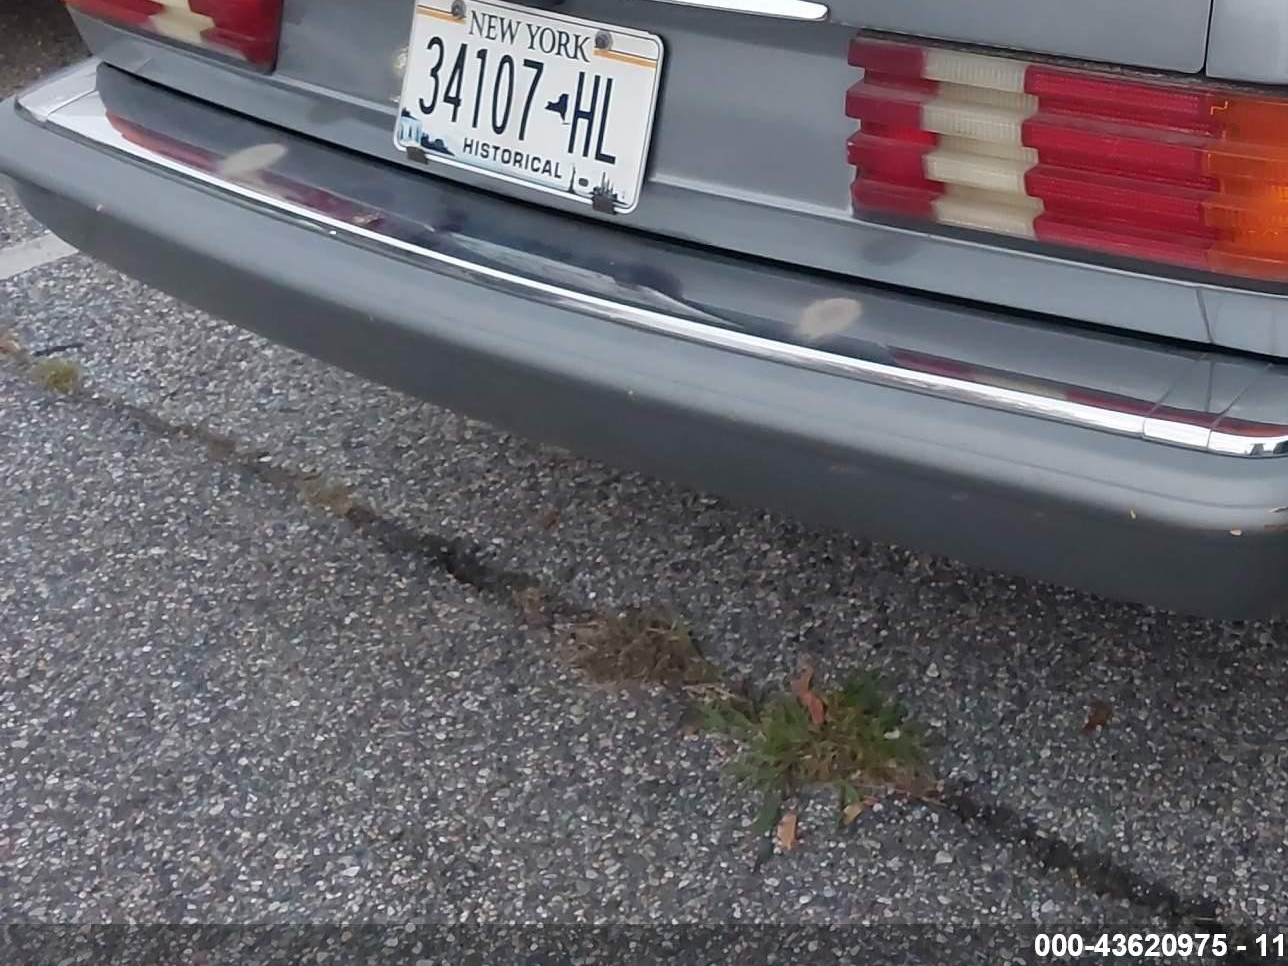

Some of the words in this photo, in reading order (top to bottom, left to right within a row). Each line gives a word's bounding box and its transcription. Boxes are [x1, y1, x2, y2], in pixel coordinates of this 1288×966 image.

[469, 10, 522, 45] NEW
[526, 23, 591, 63] YORK
[463, 137, 563, 179] HISTORICAL
